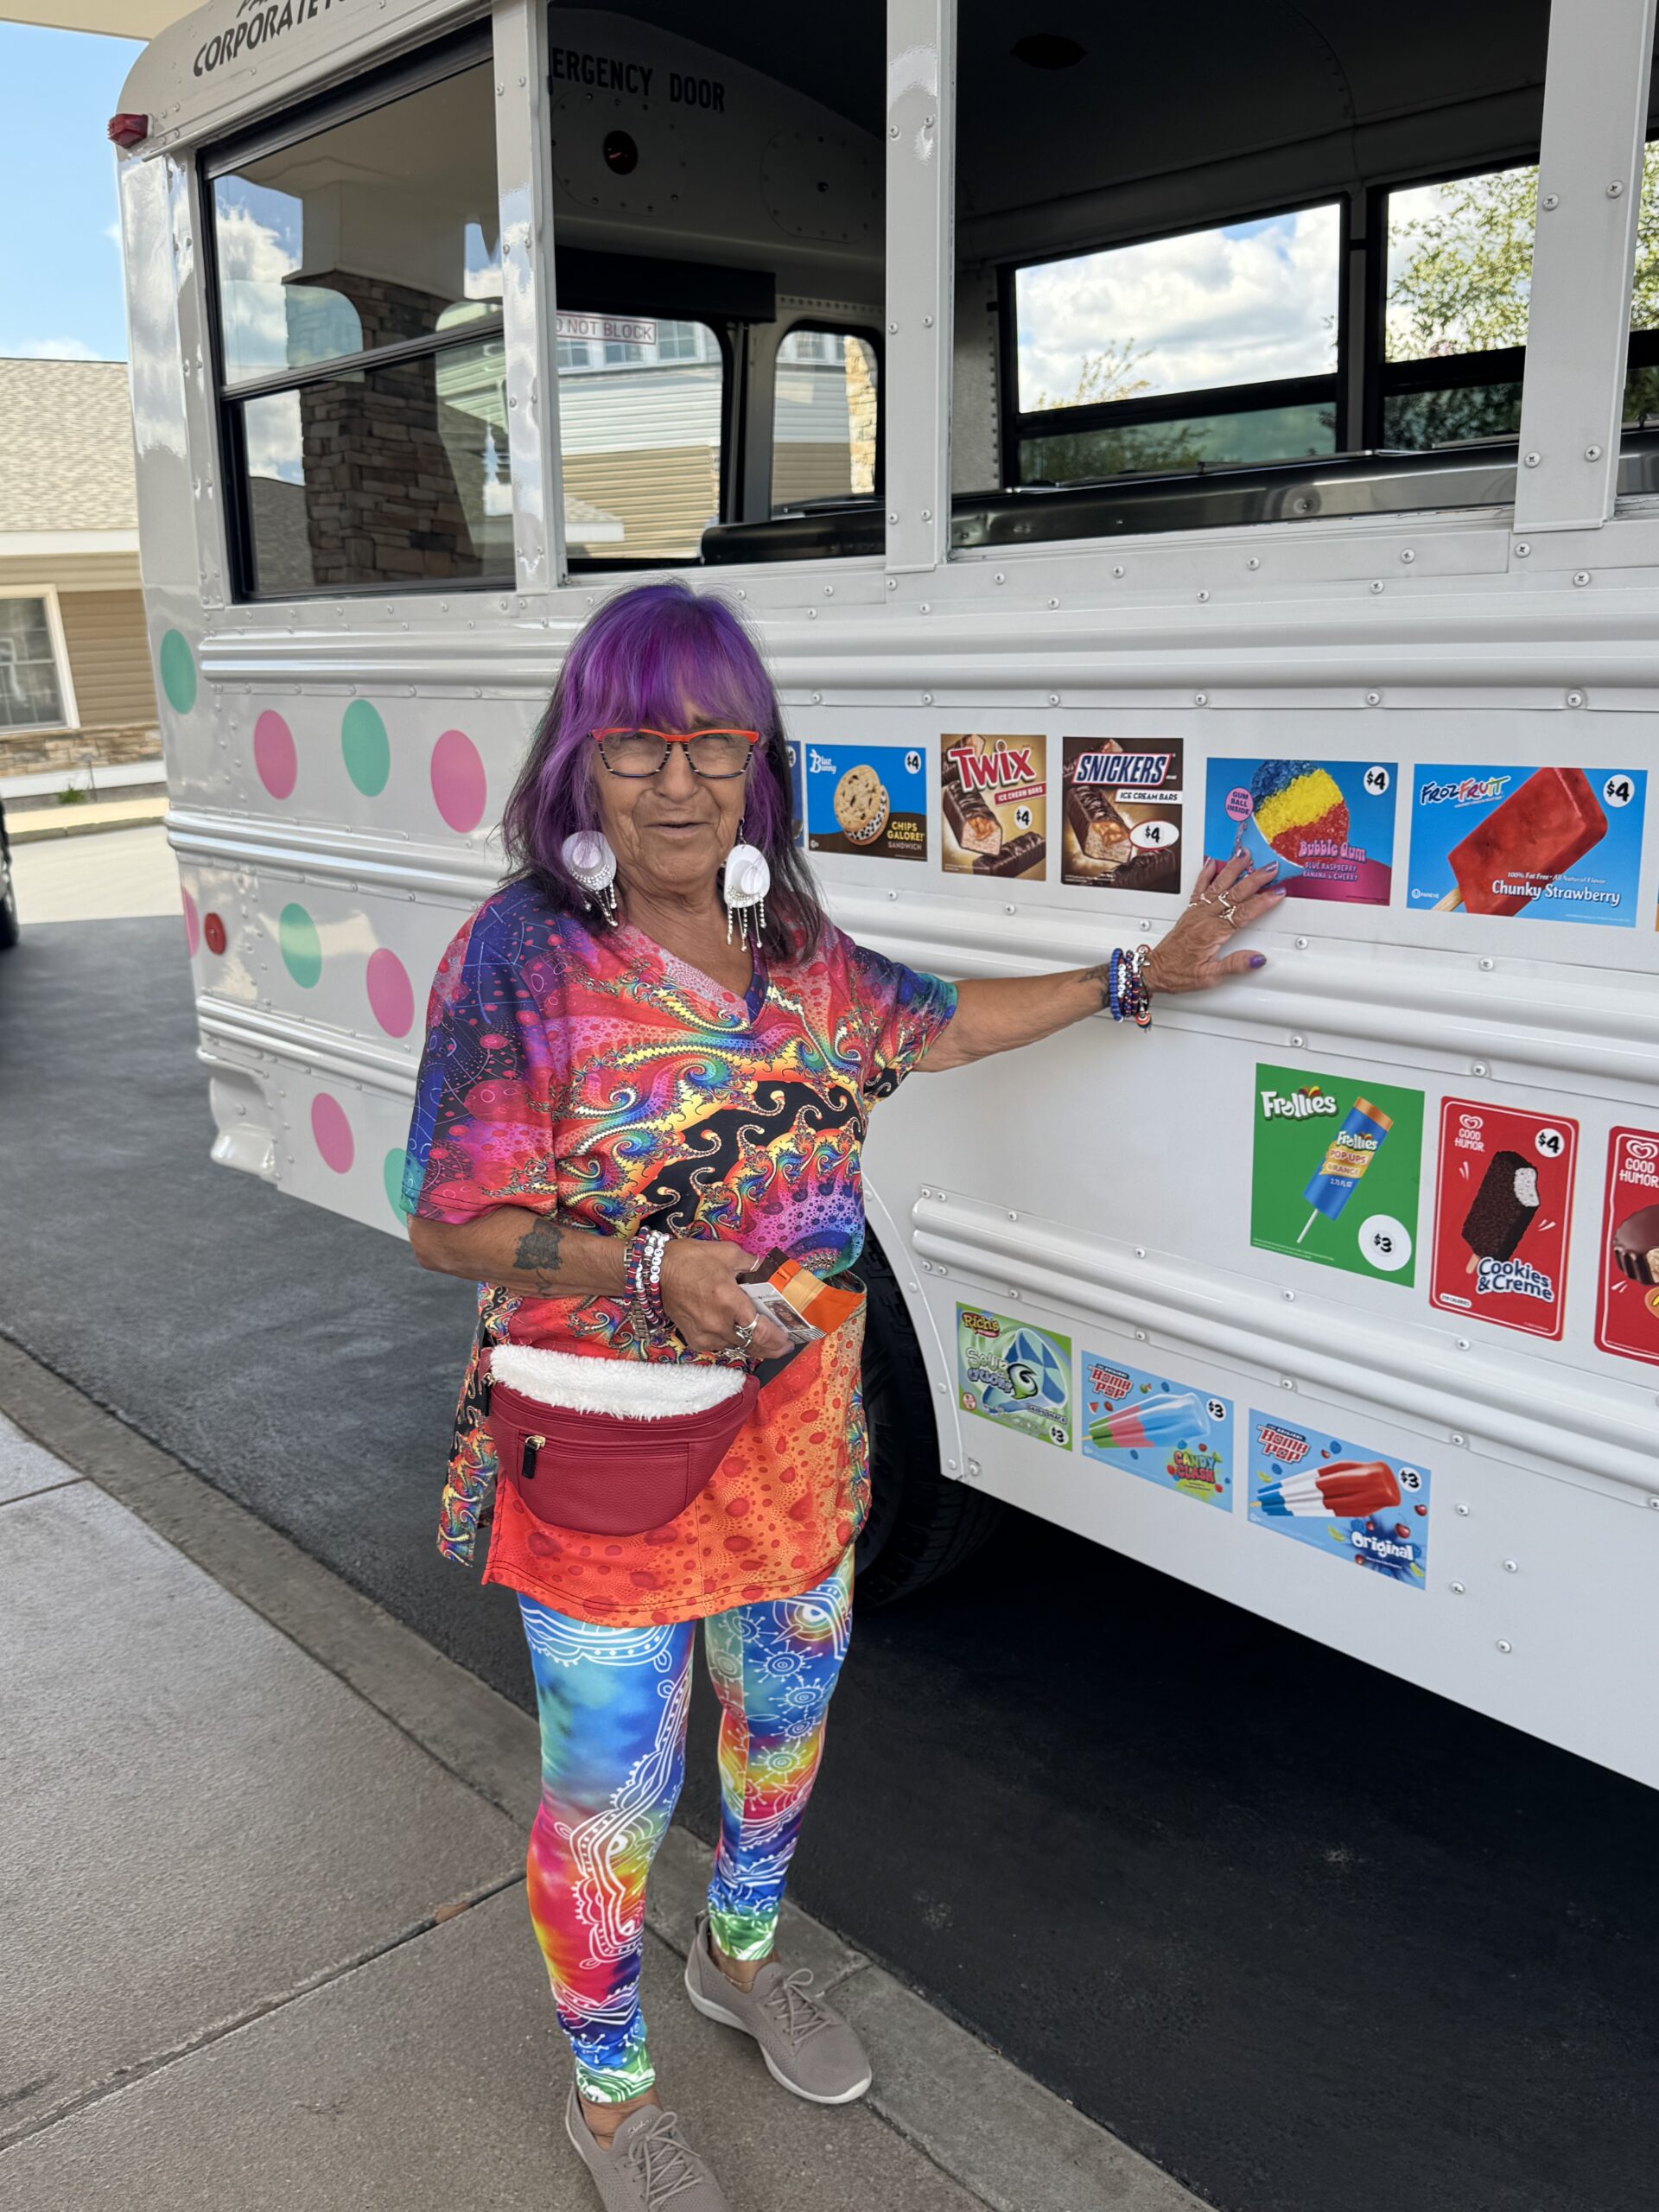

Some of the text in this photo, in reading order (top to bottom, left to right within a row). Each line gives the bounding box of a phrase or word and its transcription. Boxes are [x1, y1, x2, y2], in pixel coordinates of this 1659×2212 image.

[552, 47, 725, 112] ERGENCY DOOR
[556, 318, 653, 340] O NOT BLOCK
[907, 755, 919, 770] $4
[1076, 754, 1168, 784] SNICKERS
[1366, 771, 1386, 791] $4
[998, 786, 1043, 802] ICE CREAM BARS
[1232, 791, 1249, 799] GUM
[1607, 781, 1630, 802] $4
[1227, 804, 1250, 815] INSIDE
[1230, 798, 1248, 807] BALL
[891, 821, 918, 831] CHIPS
[1016, 810, 1029, 825] $4
[1145, 825, 1160, 843] $4
[887, 842, 922, 851] SANDWICH
[1299, 839, 1338, 857] Bubble
[1303, 870, 1326, 879] BANANA
[1333, 873, 1358, 881] CHERRY
[1320, 862, 1357, 873] RASPBERRY
[1492, 880, 1621, 907] Chunky Strawberry
[1459, 1128, 1481, 1141] GOOD
[1537, 1132, 1560, 1154] $4
[1454, 1136, 1484, 1152] HUMOR
[1624, 1158, 1656, 1173] GOOD
[1618, 1168, 1659, 1189] HUMOR
[1373, 1233, 1393, 1253] $3
[1478, 1259, 1549, 1287] Cookies
[1091, 1369, 1132, 1390] BOMB
[1095, 1382, 1126, 1398] POP
[1208, 1401, 1224, 1419] $3
[1052, 1426, 1065, 1443] $3
[1261, 1429, 1309, 1454] BOMB
[1174, 1450, 1216, 1471] CANDY
[1265, 1443, 1301, 1461] POP
[1176, 1465, 1216, 1484] CLASH
[1401, 1470, 1420, 1489] $3
[1351, 1531, 1414, 1560] Original
